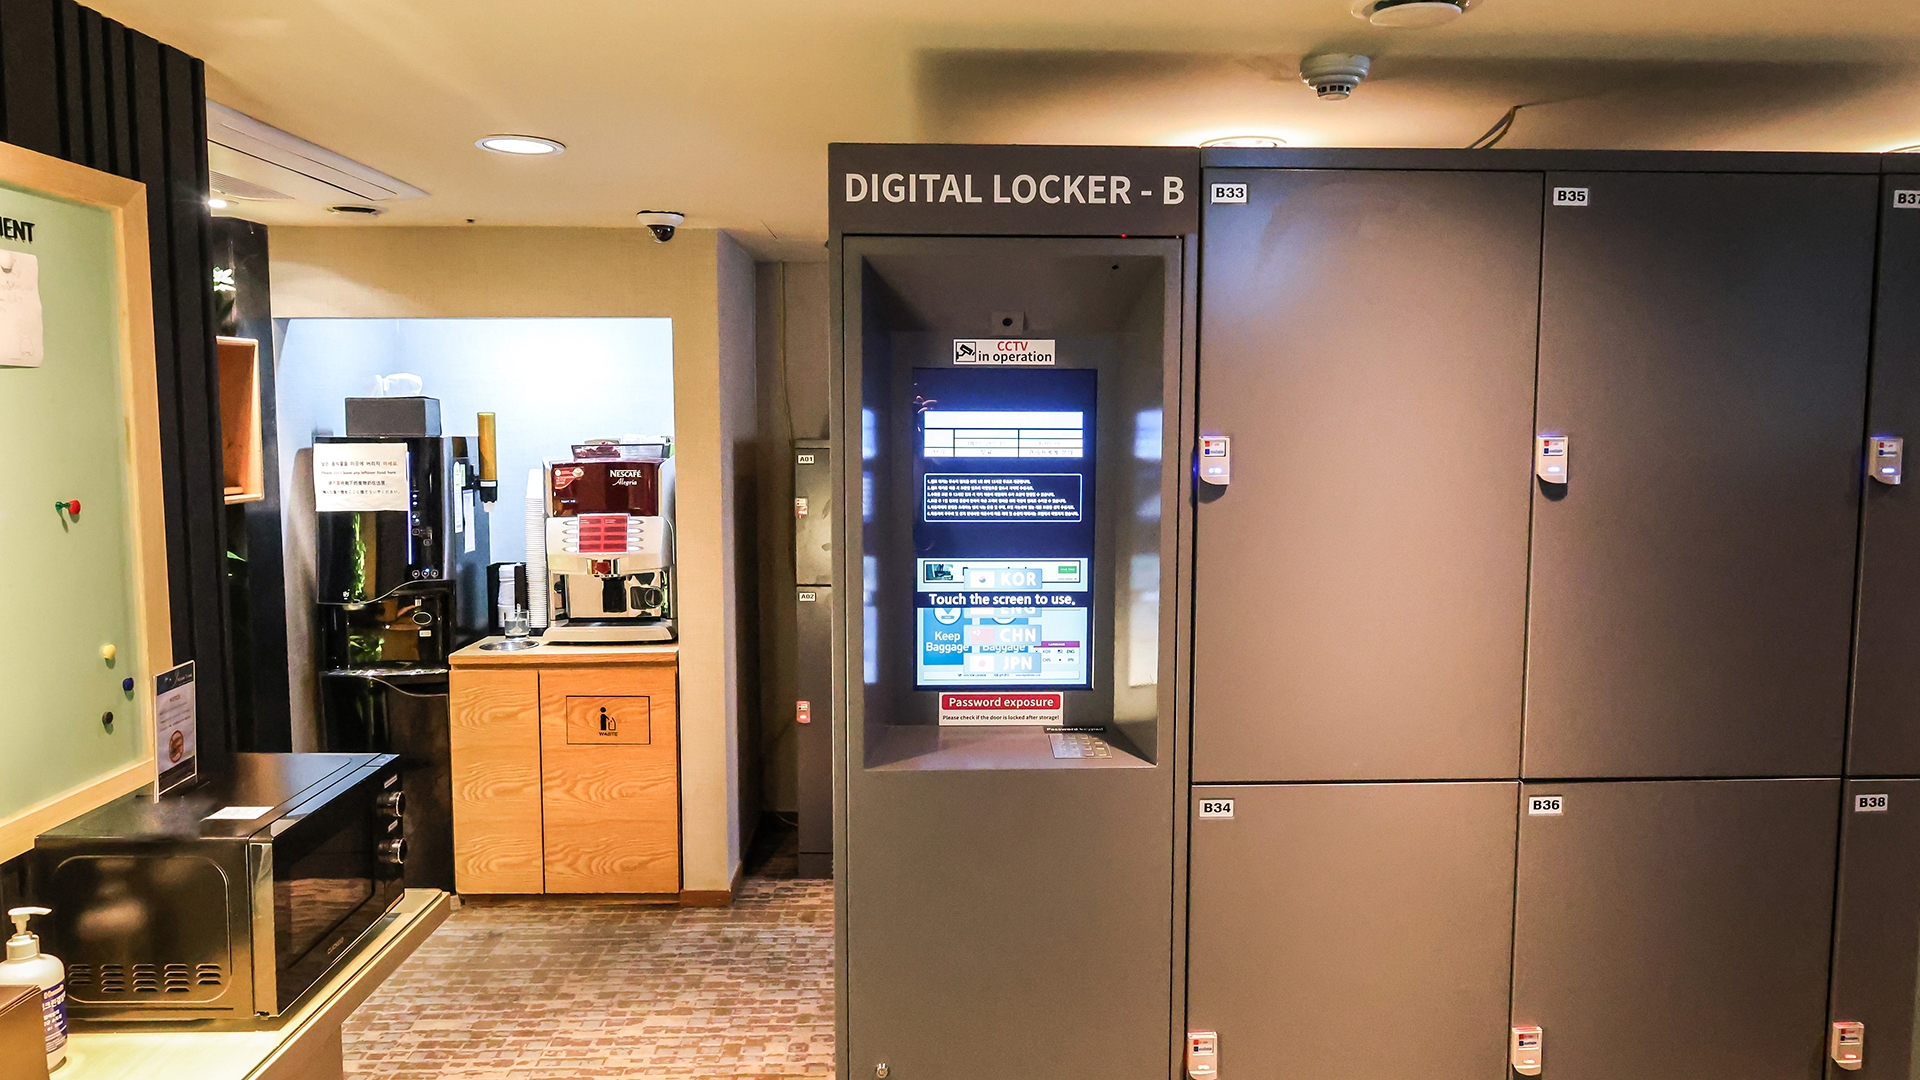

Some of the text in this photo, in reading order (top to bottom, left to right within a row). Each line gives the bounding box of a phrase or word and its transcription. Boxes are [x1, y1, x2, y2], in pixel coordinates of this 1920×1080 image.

[845, 173, 982, 203] DIGITAL
[993, 174, 1131, 205] LOCKER
[1163, 176, 1185, 205] B
[1216, 187, 1244, 198] B33
[1557, 190, 1586, 202] B35
[0, 217, 35, 243] ENT
[997, 341, 1029, 352] CCTV
[978, 351, 1052, 364] in operation
[609, 469, 641, 478] NESCAFÉ
[1000, 571, 1036, 586] KOR
[929, 593, 1076, 606] Touch the screen to use.
[934, 631, 960, 643] Keep
[999, 628, 1036, 642] CHN
[925, 642, 969, 654] Baggage
[1003, 656, 1033, 671] JPN
[949, 697, 1054, 709] Password exposure
[1204, 802, 1231, 813] B34
[1533, 799, 1560, 811] B36
[1859, 797, 1886, 808] B38
